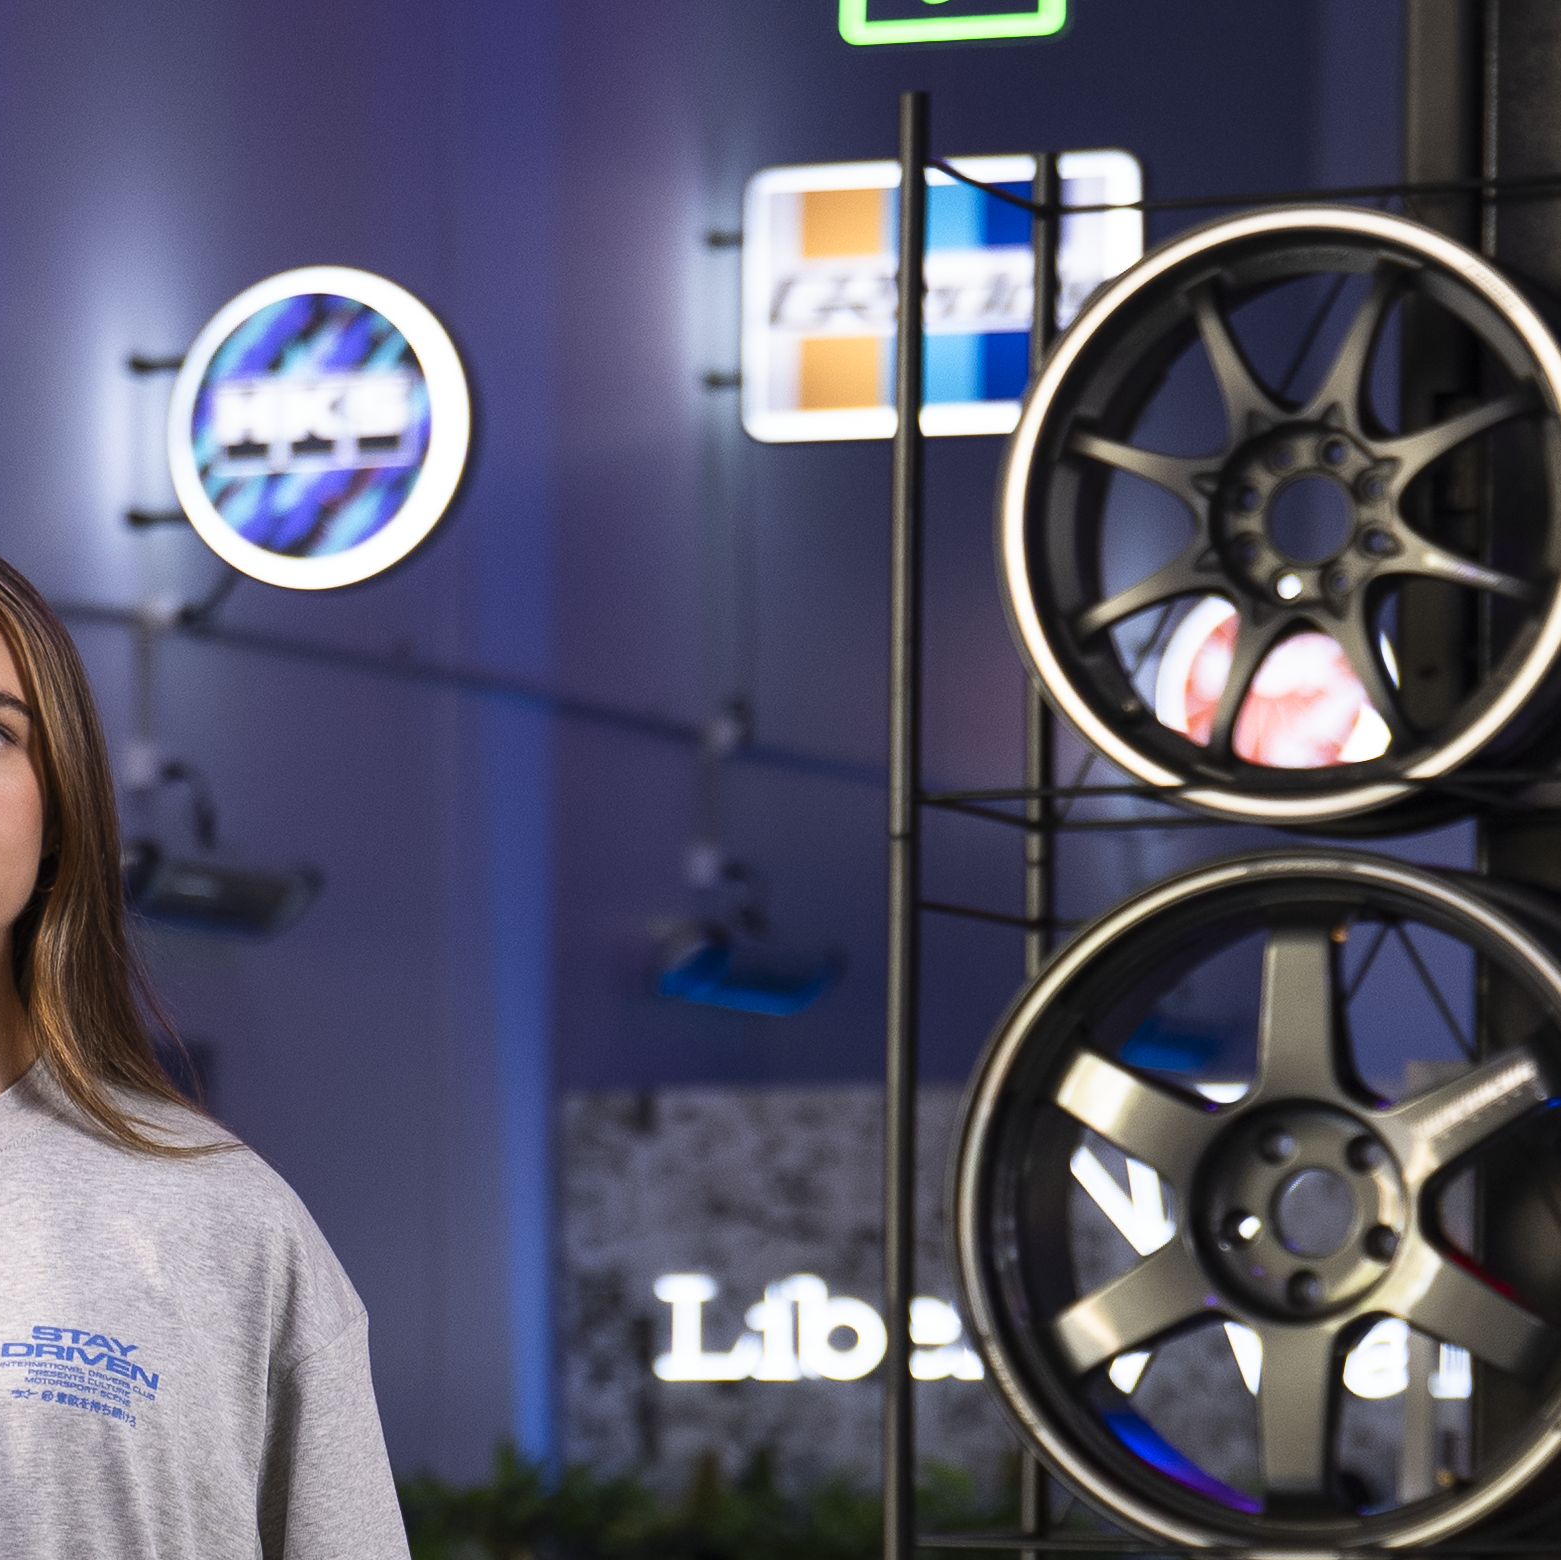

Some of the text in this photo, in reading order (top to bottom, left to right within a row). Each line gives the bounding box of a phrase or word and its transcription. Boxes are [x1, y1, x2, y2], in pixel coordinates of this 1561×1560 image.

[31, 1325, 139, 1358] STAY
[652, 1273, 985, 1382] Libe
[0, 1342, 160, 1391] DRIVEN
[0, 1361, 156, 1401] INTERNATIONAL DRIVERS CLUB
[27, 1368, 132, 1399] PRESENTS CULTURE
[24, 1376, 132, 1408] MOTORSPORT SCENE
